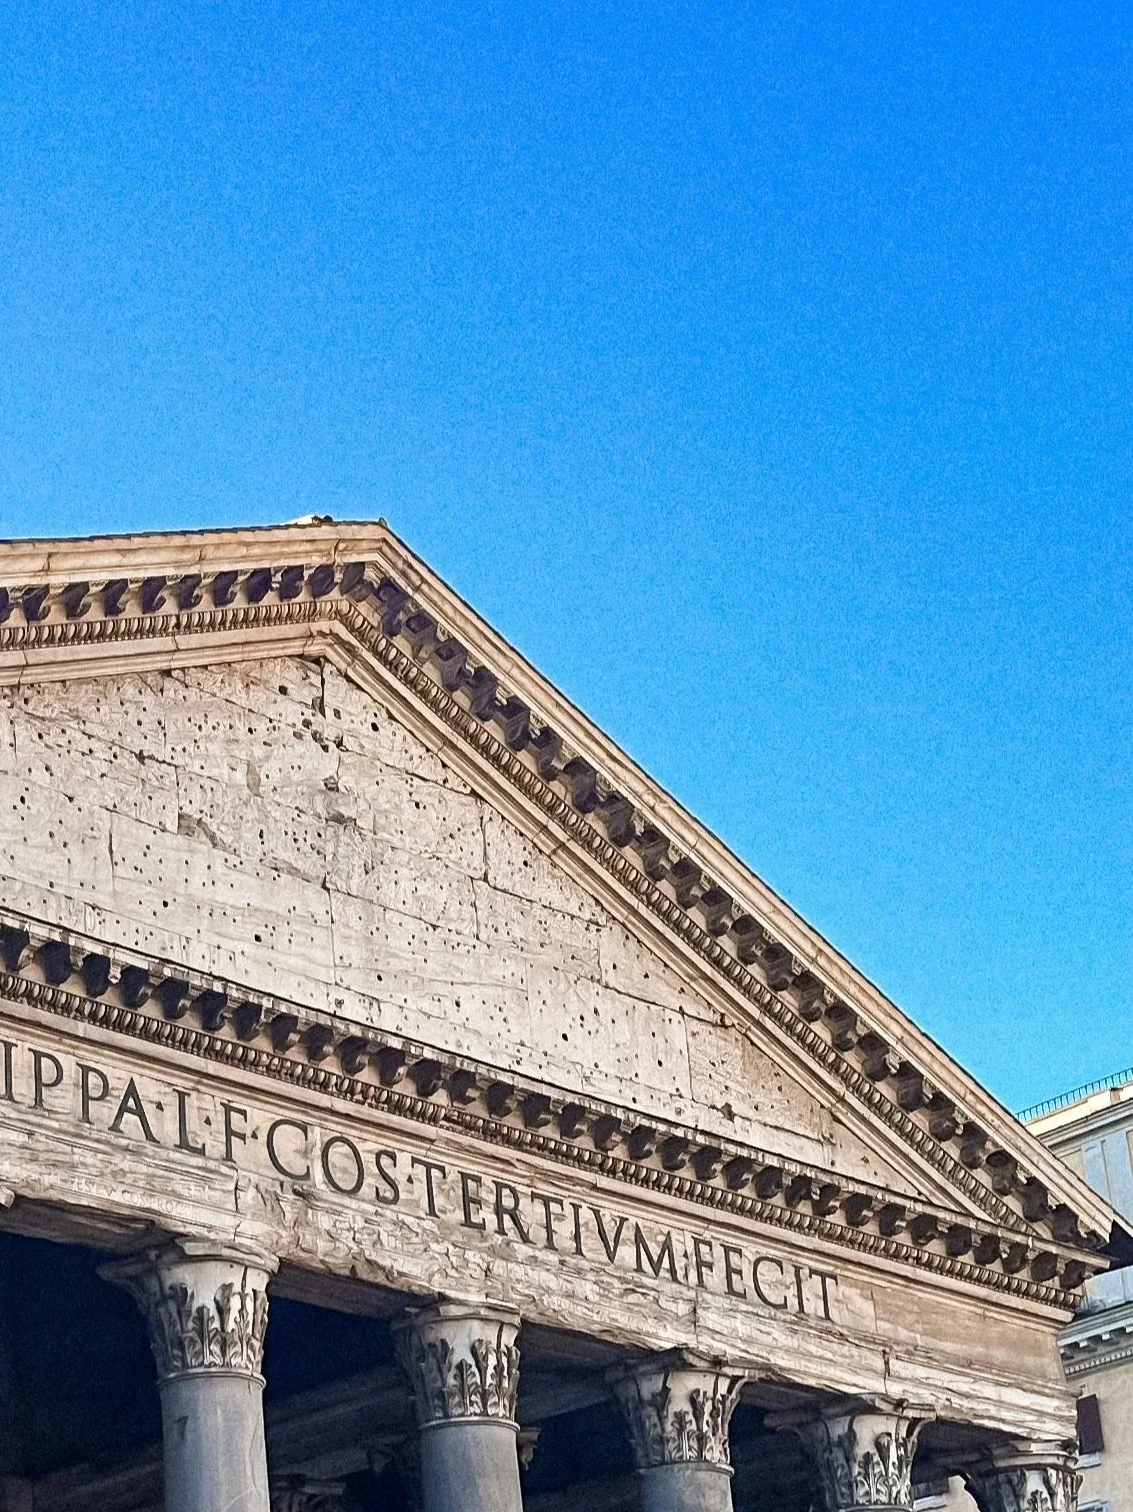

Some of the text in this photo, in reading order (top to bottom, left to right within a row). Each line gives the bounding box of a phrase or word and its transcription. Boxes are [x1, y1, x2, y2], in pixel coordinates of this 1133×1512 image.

[172, 1089, 206, 1155] L
[222, 1101, 248, 1163] F
[266, 1118, 400, 1205] COS
[412, 1159, 680, 1281] TERTIVM
[691, 1236, 840, 1320] FECIT
